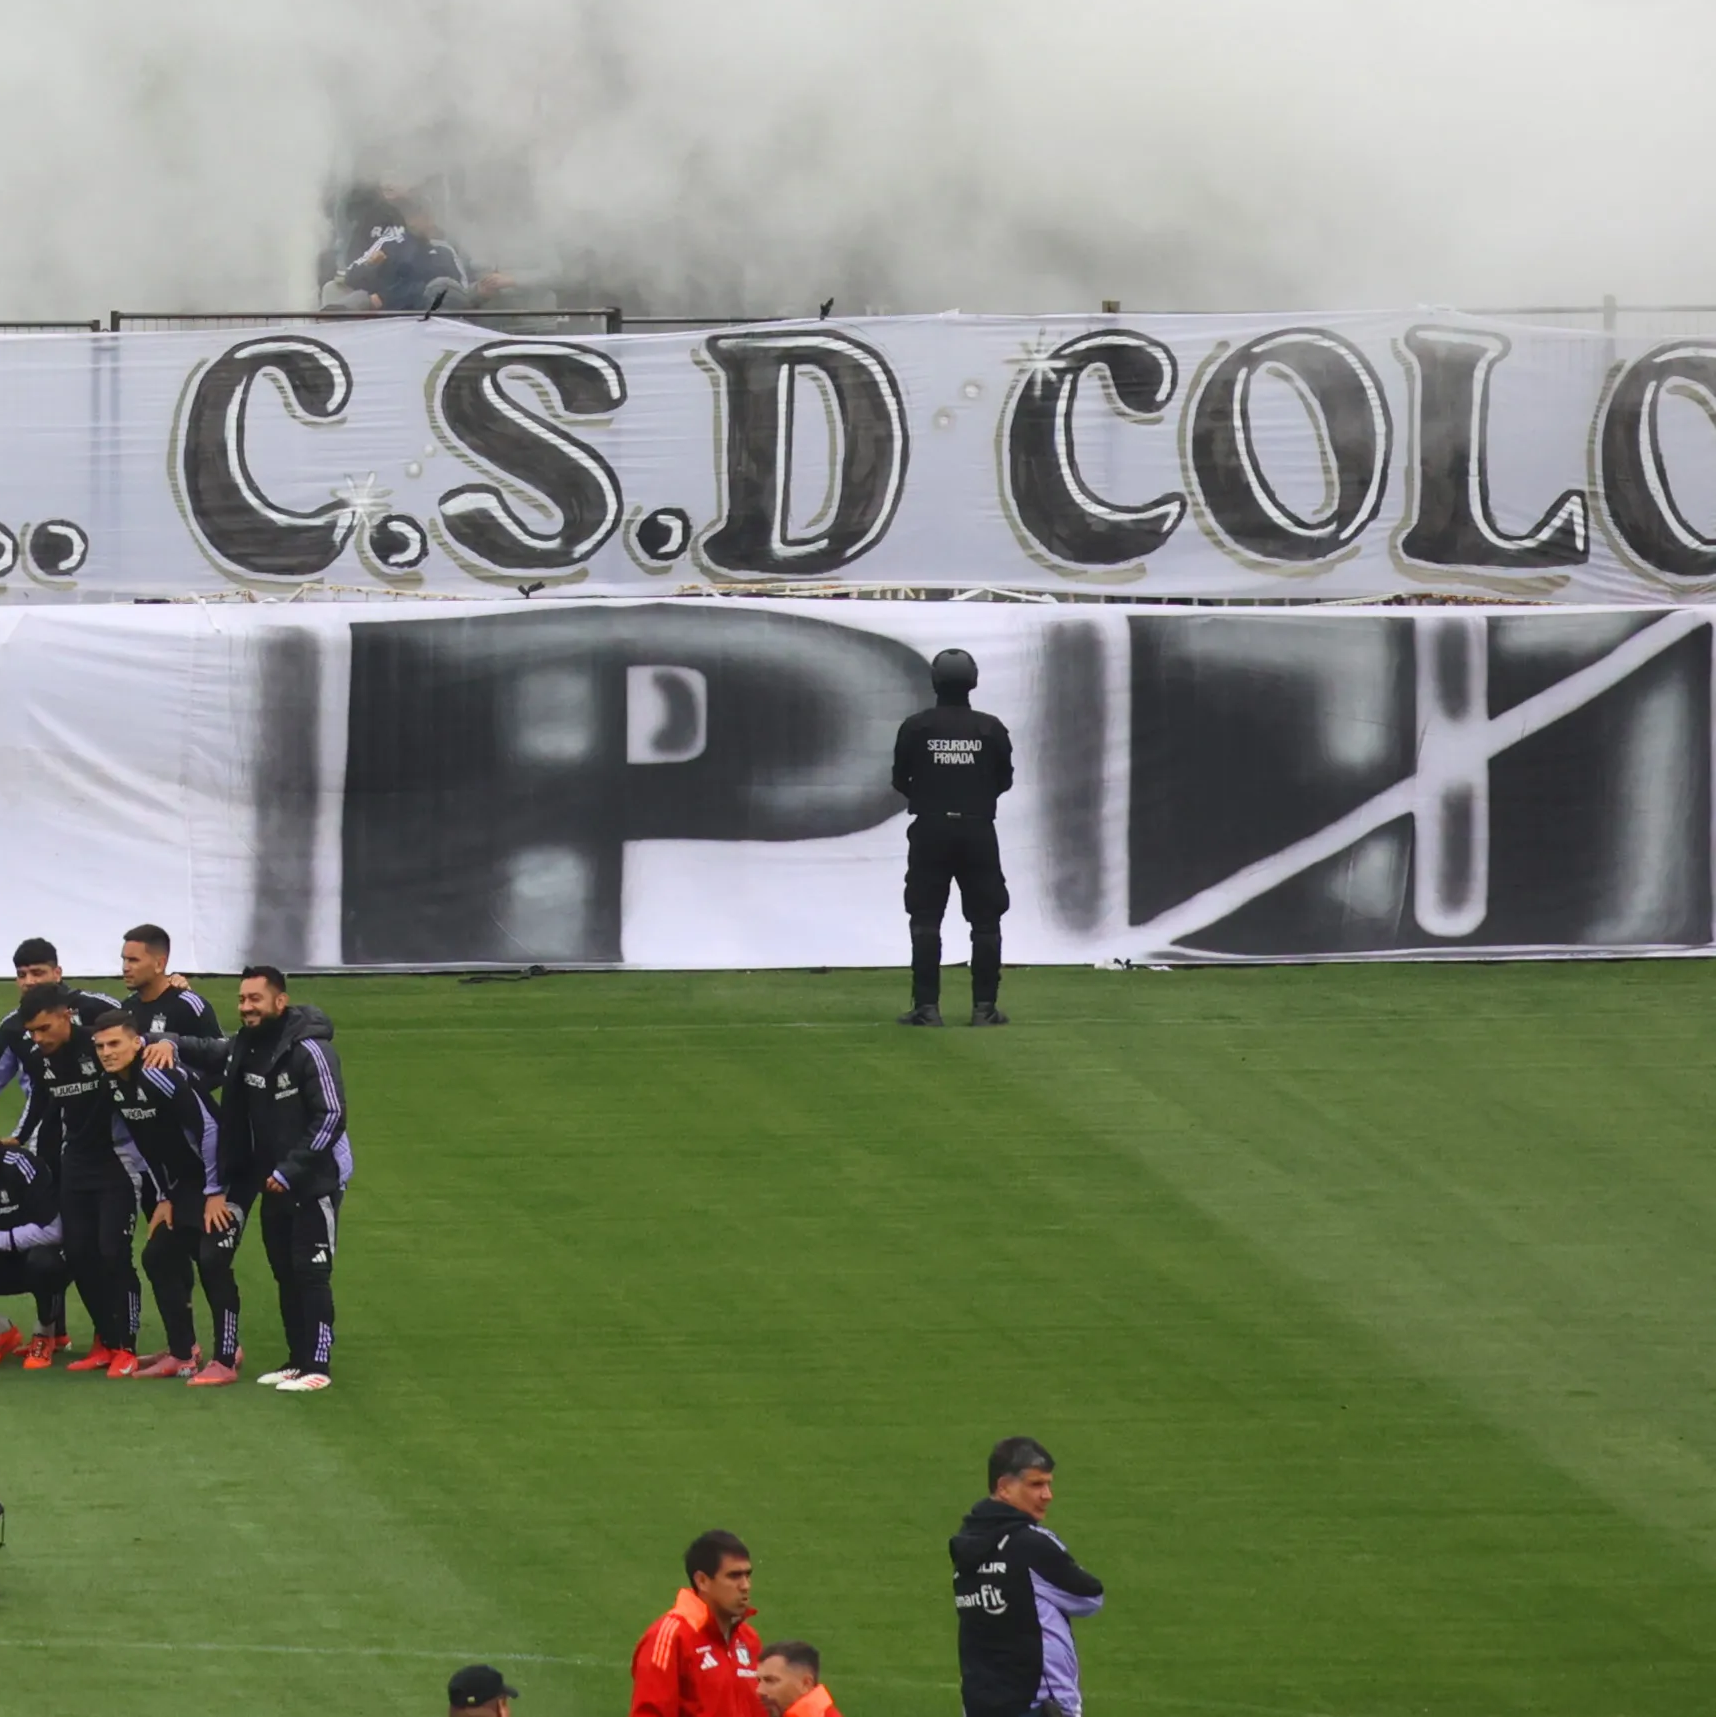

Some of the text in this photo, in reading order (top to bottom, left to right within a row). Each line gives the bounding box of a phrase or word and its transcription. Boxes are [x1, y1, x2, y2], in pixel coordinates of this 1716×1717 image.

[172, 331, 911, 579] C.S.D
[927, 739, 982, 751] SEGURIDAD
[933, 753, 975, 764] PRIVADA
